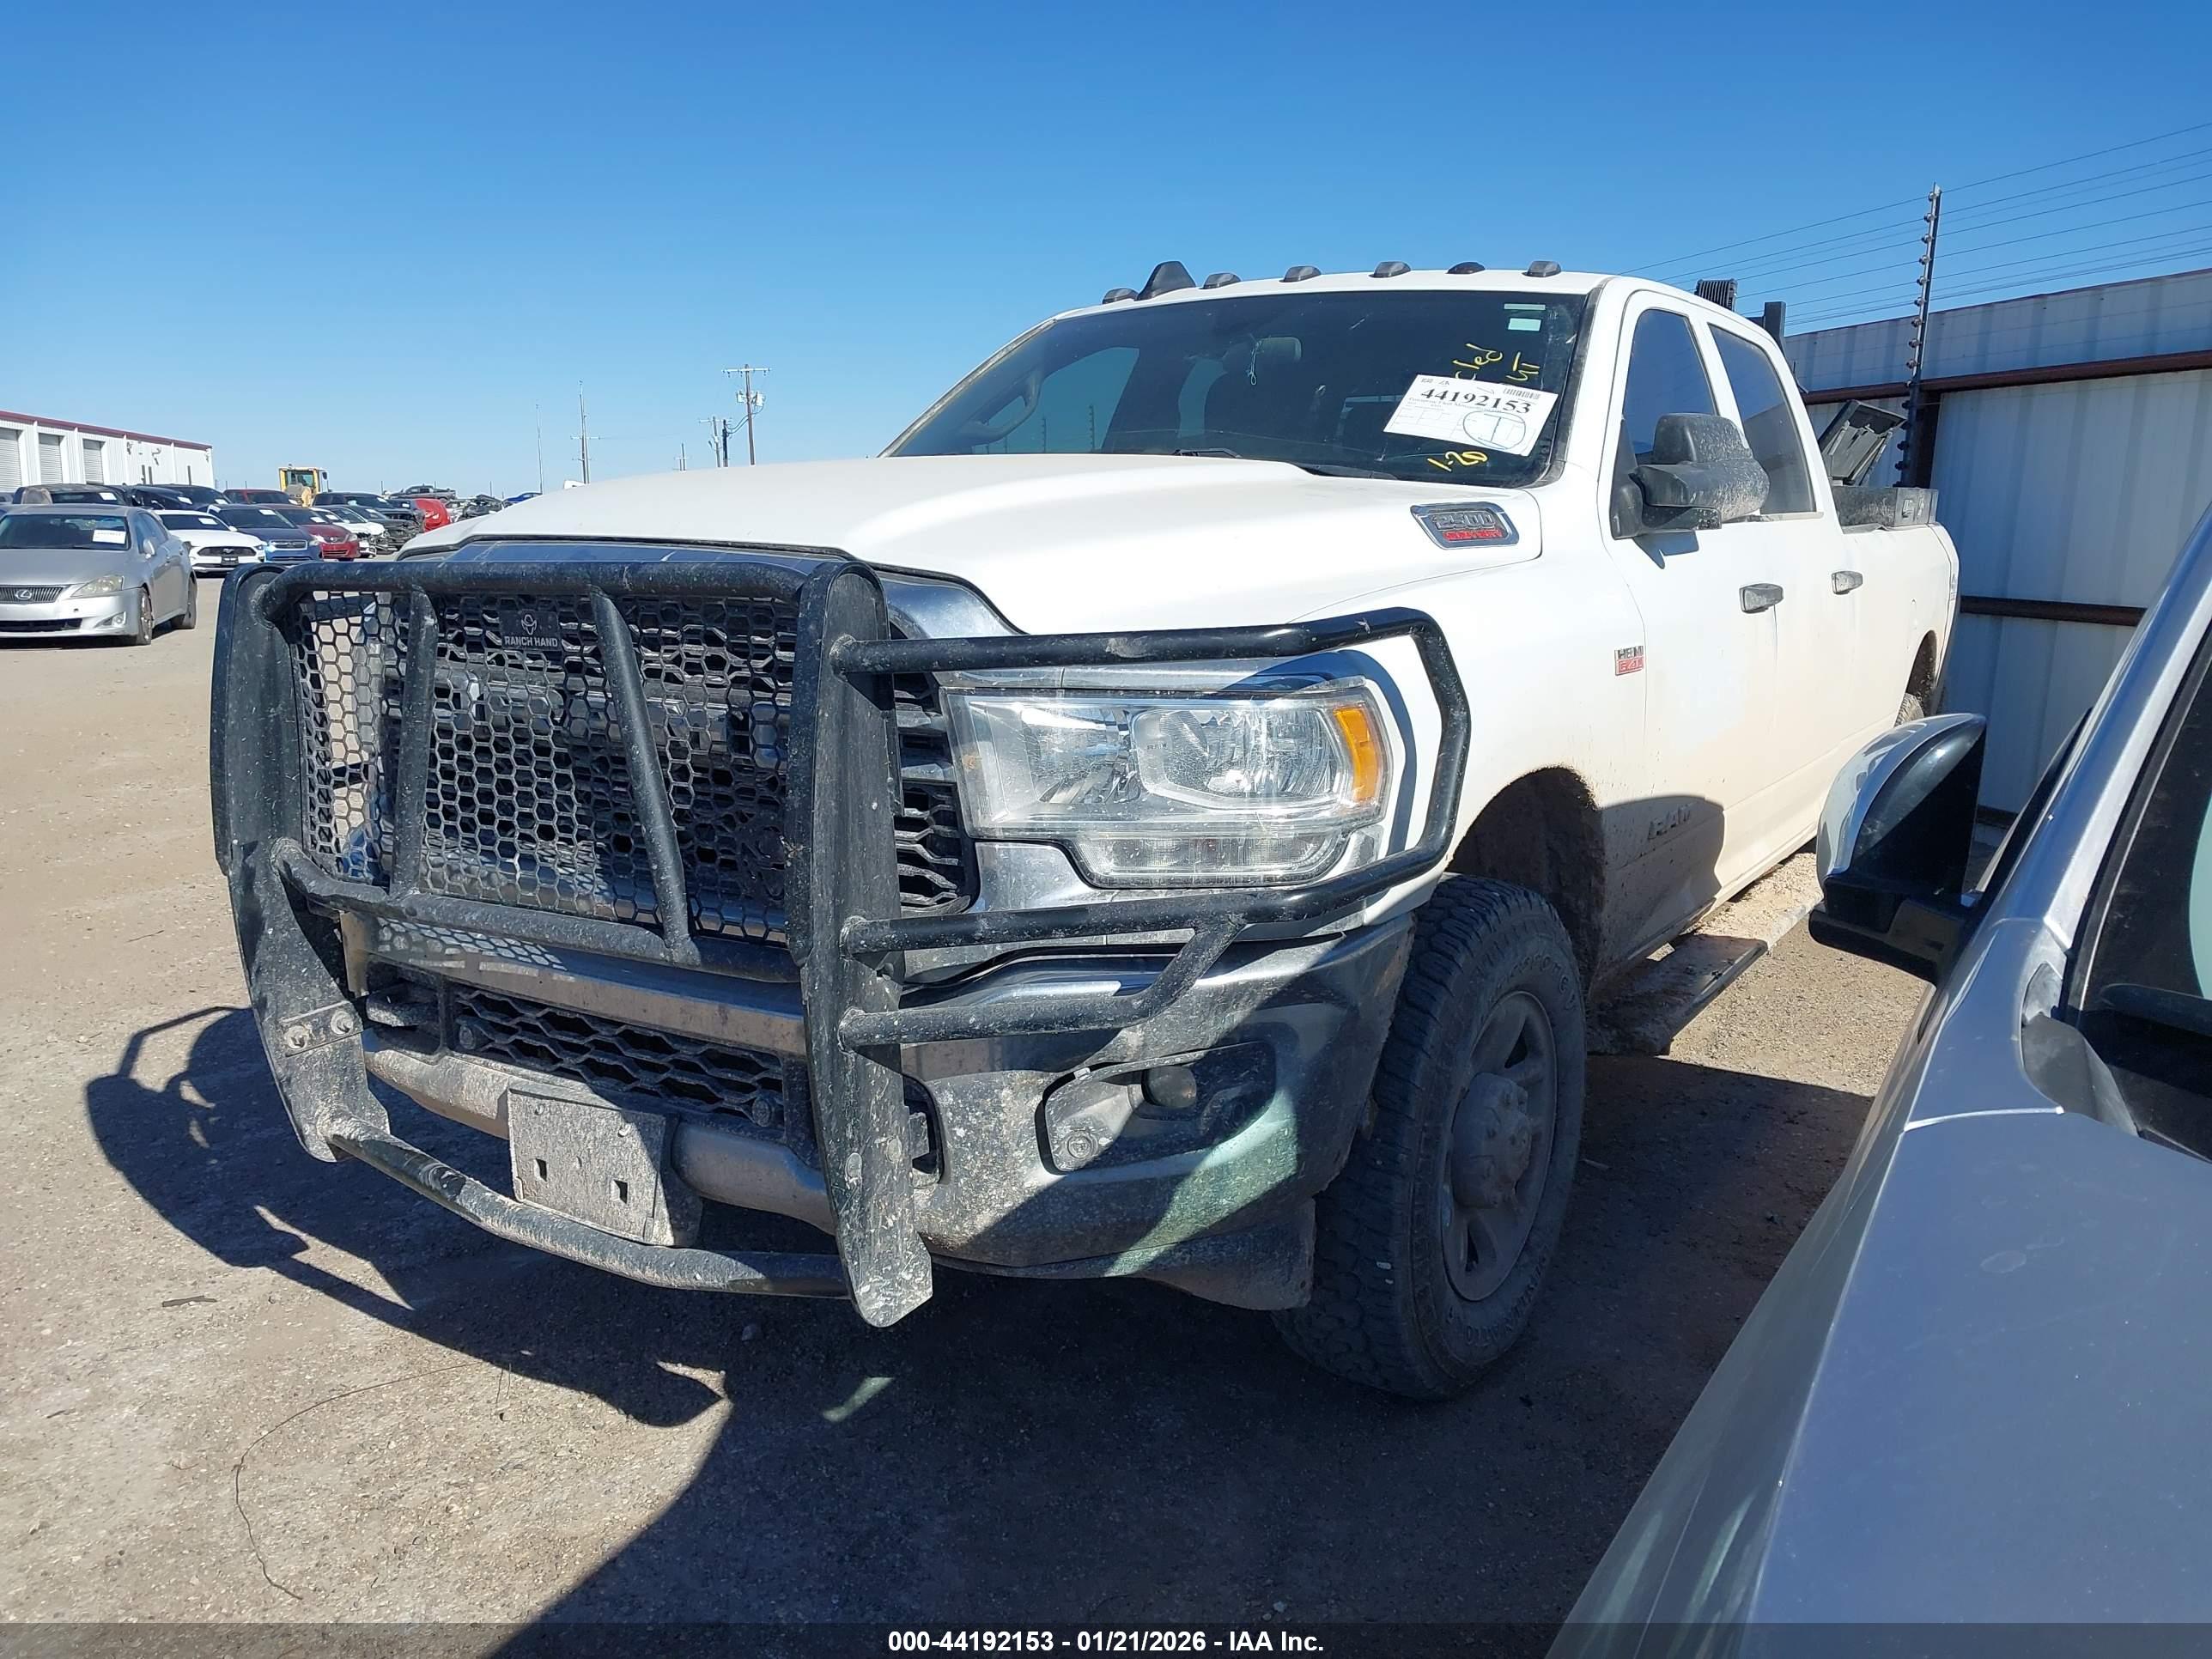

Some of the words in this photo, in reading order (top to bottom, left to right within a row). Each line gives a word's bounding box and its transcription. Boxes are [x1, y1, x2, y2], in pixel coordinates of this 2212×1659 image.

[1421, 388, 1531, 414] 44192153
[1432, 514, 1496, 530] 2500
[504, 635, 532, 647] RANCH
[534, 637, 558, 647] HAND
